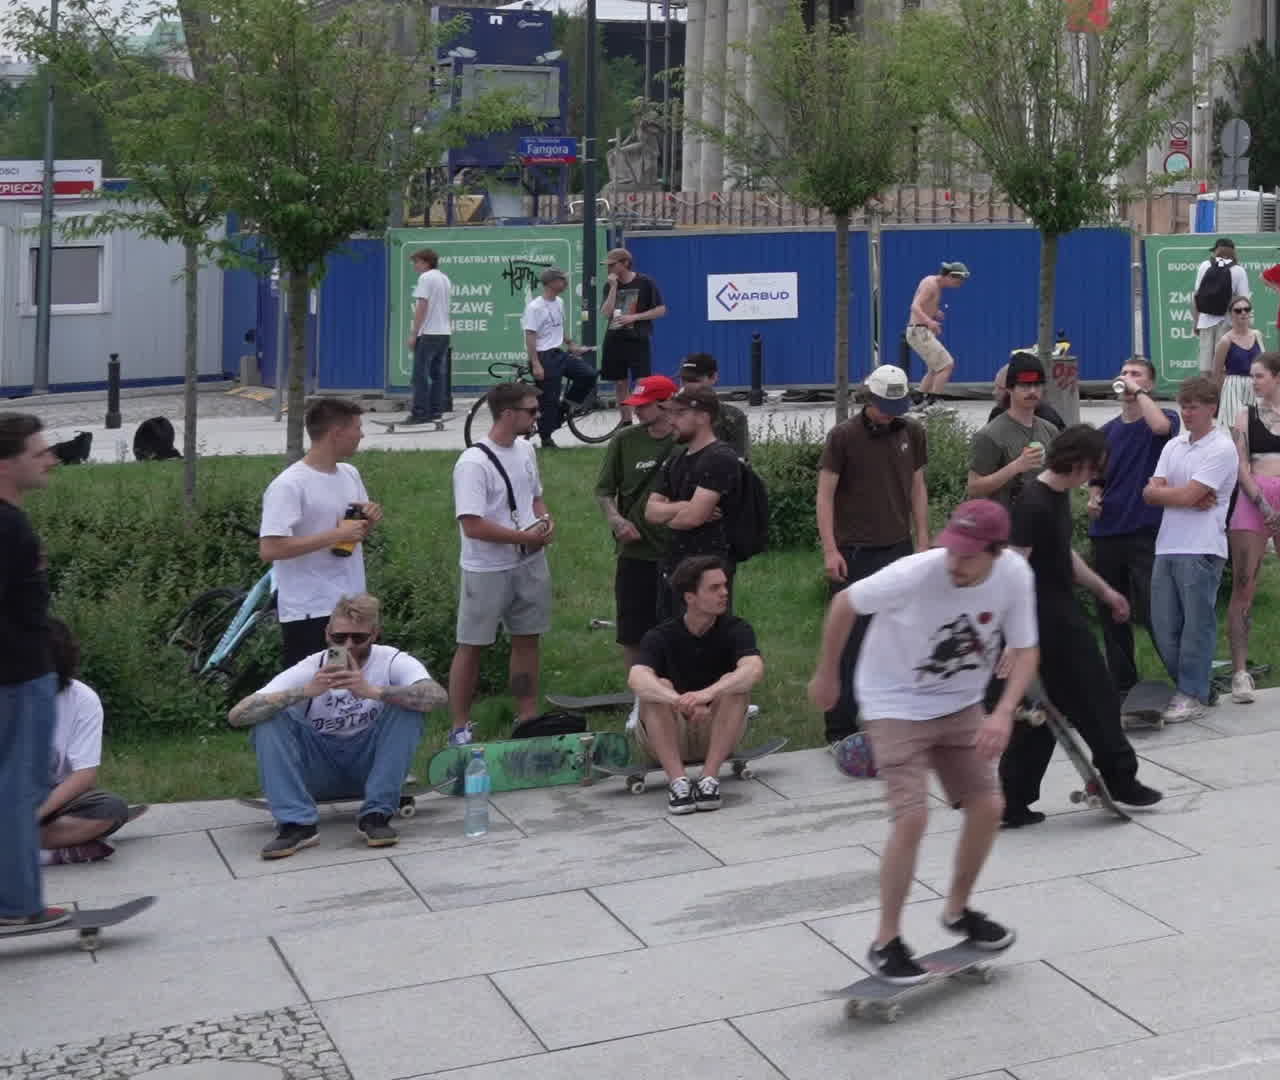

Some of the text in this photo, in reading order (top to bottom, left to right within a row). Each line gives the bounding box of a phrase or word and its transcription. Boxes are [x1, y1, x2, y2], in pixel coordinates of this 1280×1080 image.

[527, 143, 569, 157] Fangora
[727, 291, 790, 301] WARBUD
[311, 708, 378, 730] DESTRO
